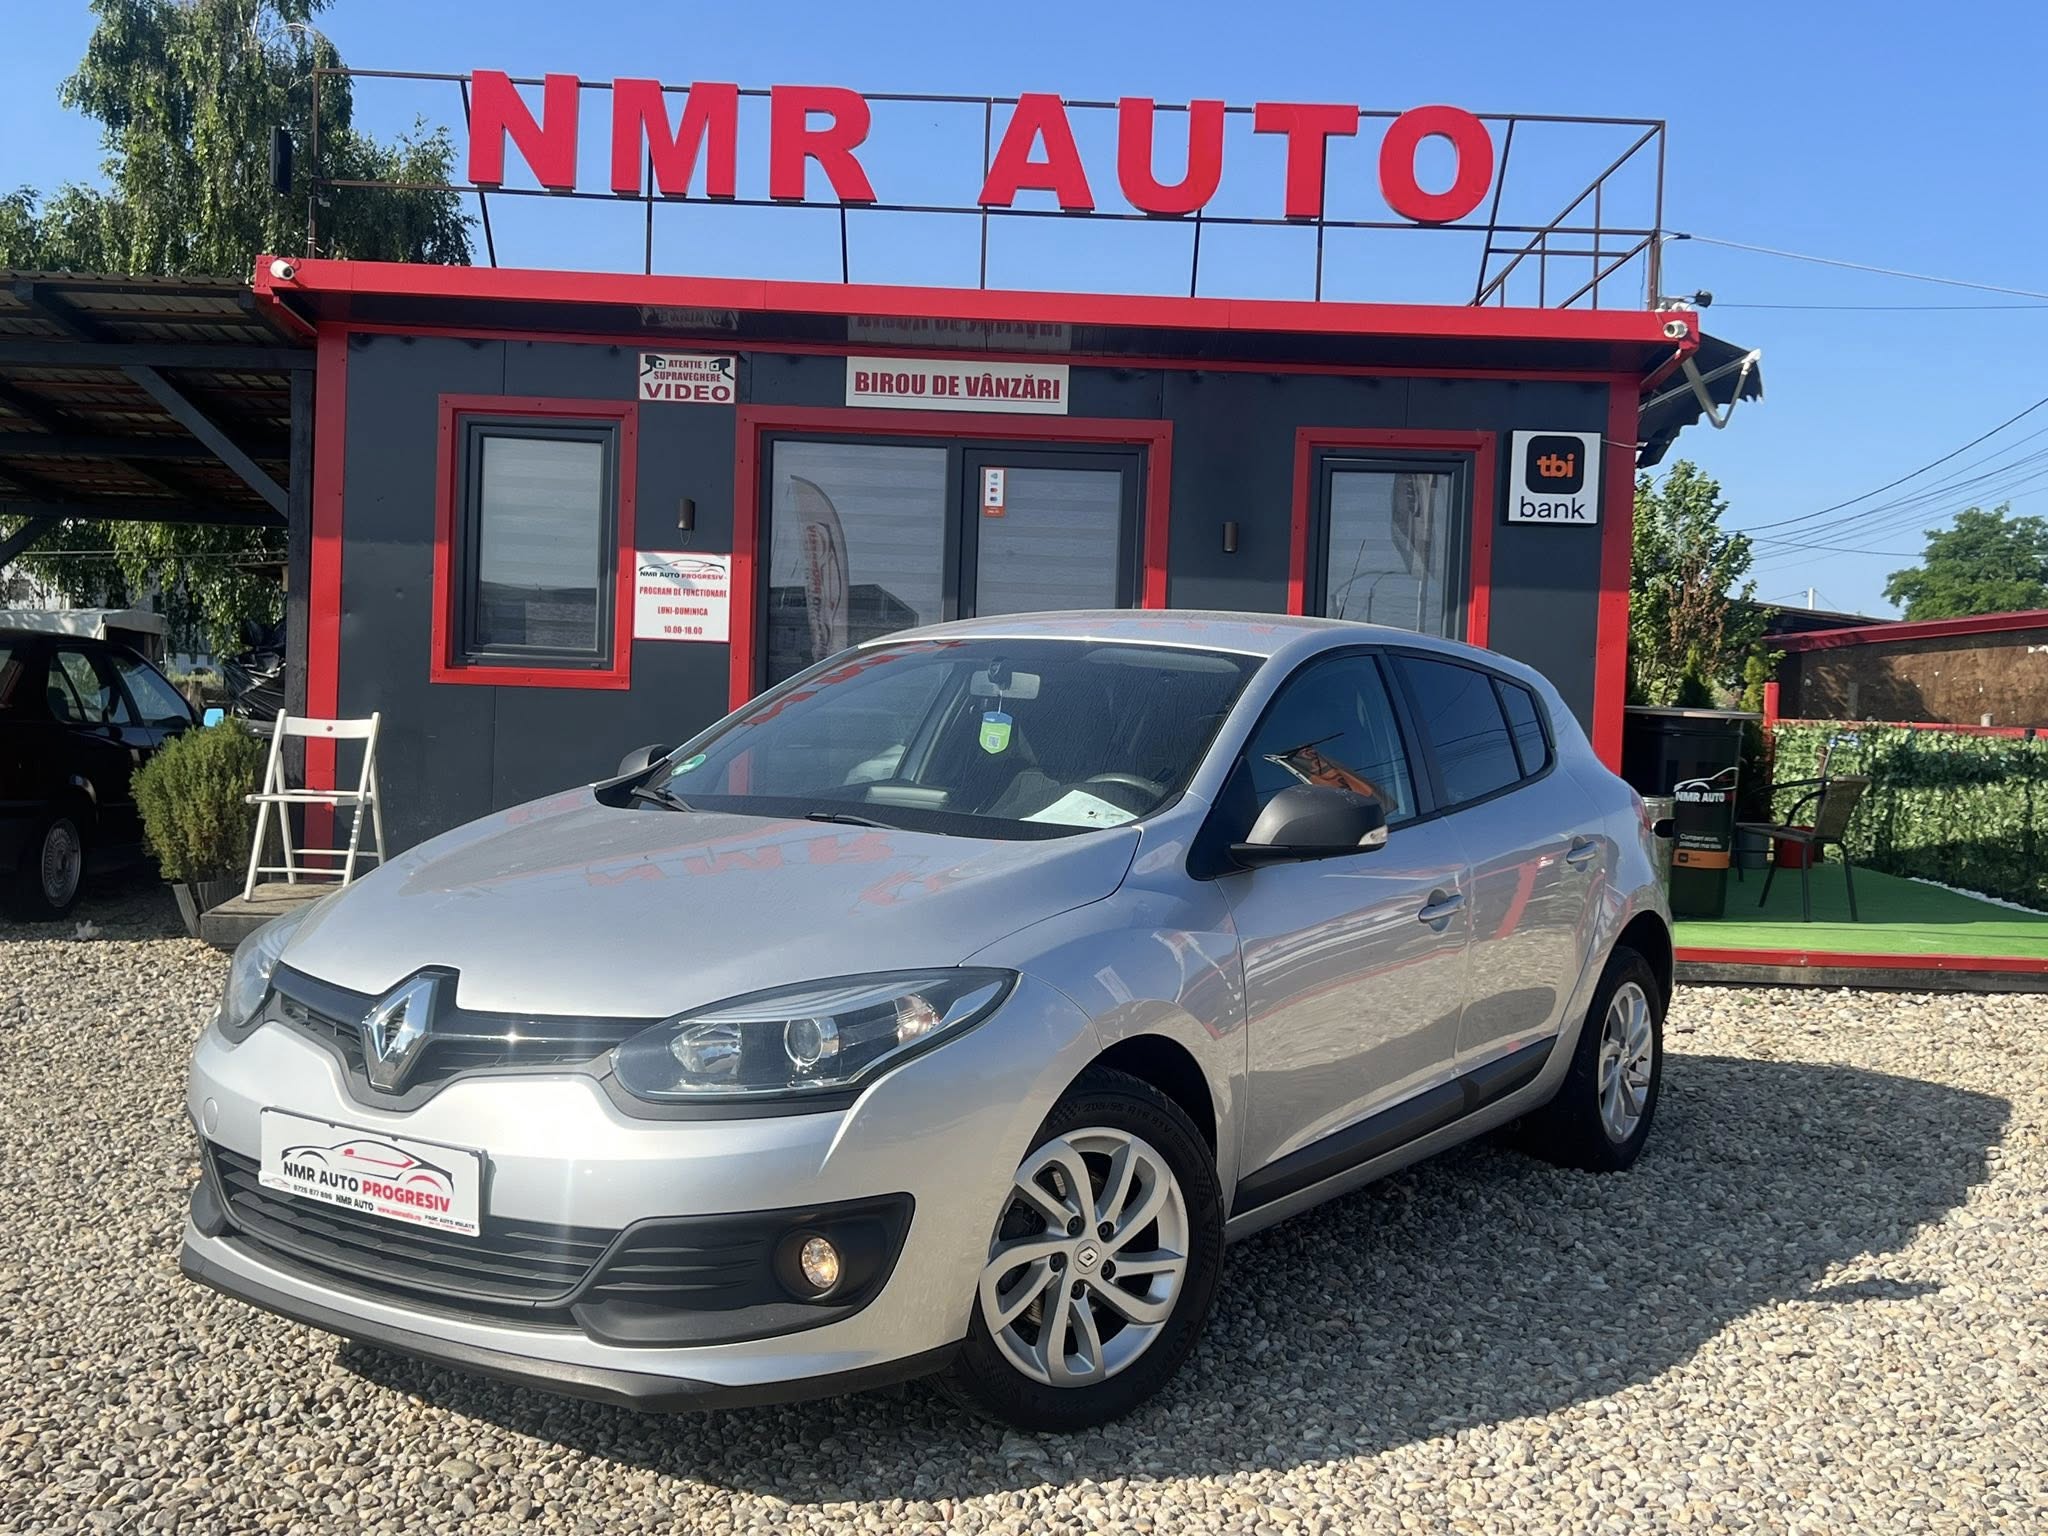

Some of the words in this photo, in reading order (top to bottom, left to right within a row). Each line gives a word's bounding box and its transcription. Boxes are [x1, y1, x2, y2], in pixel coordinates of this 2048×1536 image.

[468, 70, 877, 202] NMR
[977, 92, 1494, 224] AUTO
[653, 371, 721, 383] SUPRAVEGHERE
[855, 371, 926, 395] BIROU
[932, 375, 959, 396] DE
[964, 373, 1060, 400] VÂNZĂRI
[644, 383, 731, 401] VIDEO
[1537, 453, 1575, 478] tbi
[1520, 495, 1585, 519] bank
[640, 586, 672, 596] PROGRAM
[673, 587, 681, 596] DE
[683, 588, 727, 598] FUNCTIONARE
[657, 606, 708, 616] LUNI-DUMINICA
[1675, 791, 1700, 803] NMR
[1701, 792, 1725, 803] AUTO
[283, 1160, 316, 1183] NMR
[319, 1170, 359, 1193] AUTO
[362, 1180, 451, 1213] PROGRESIV
[335, 1194, 352, 1206] NMR
[353, 1199, 374, 1212] AUTO
